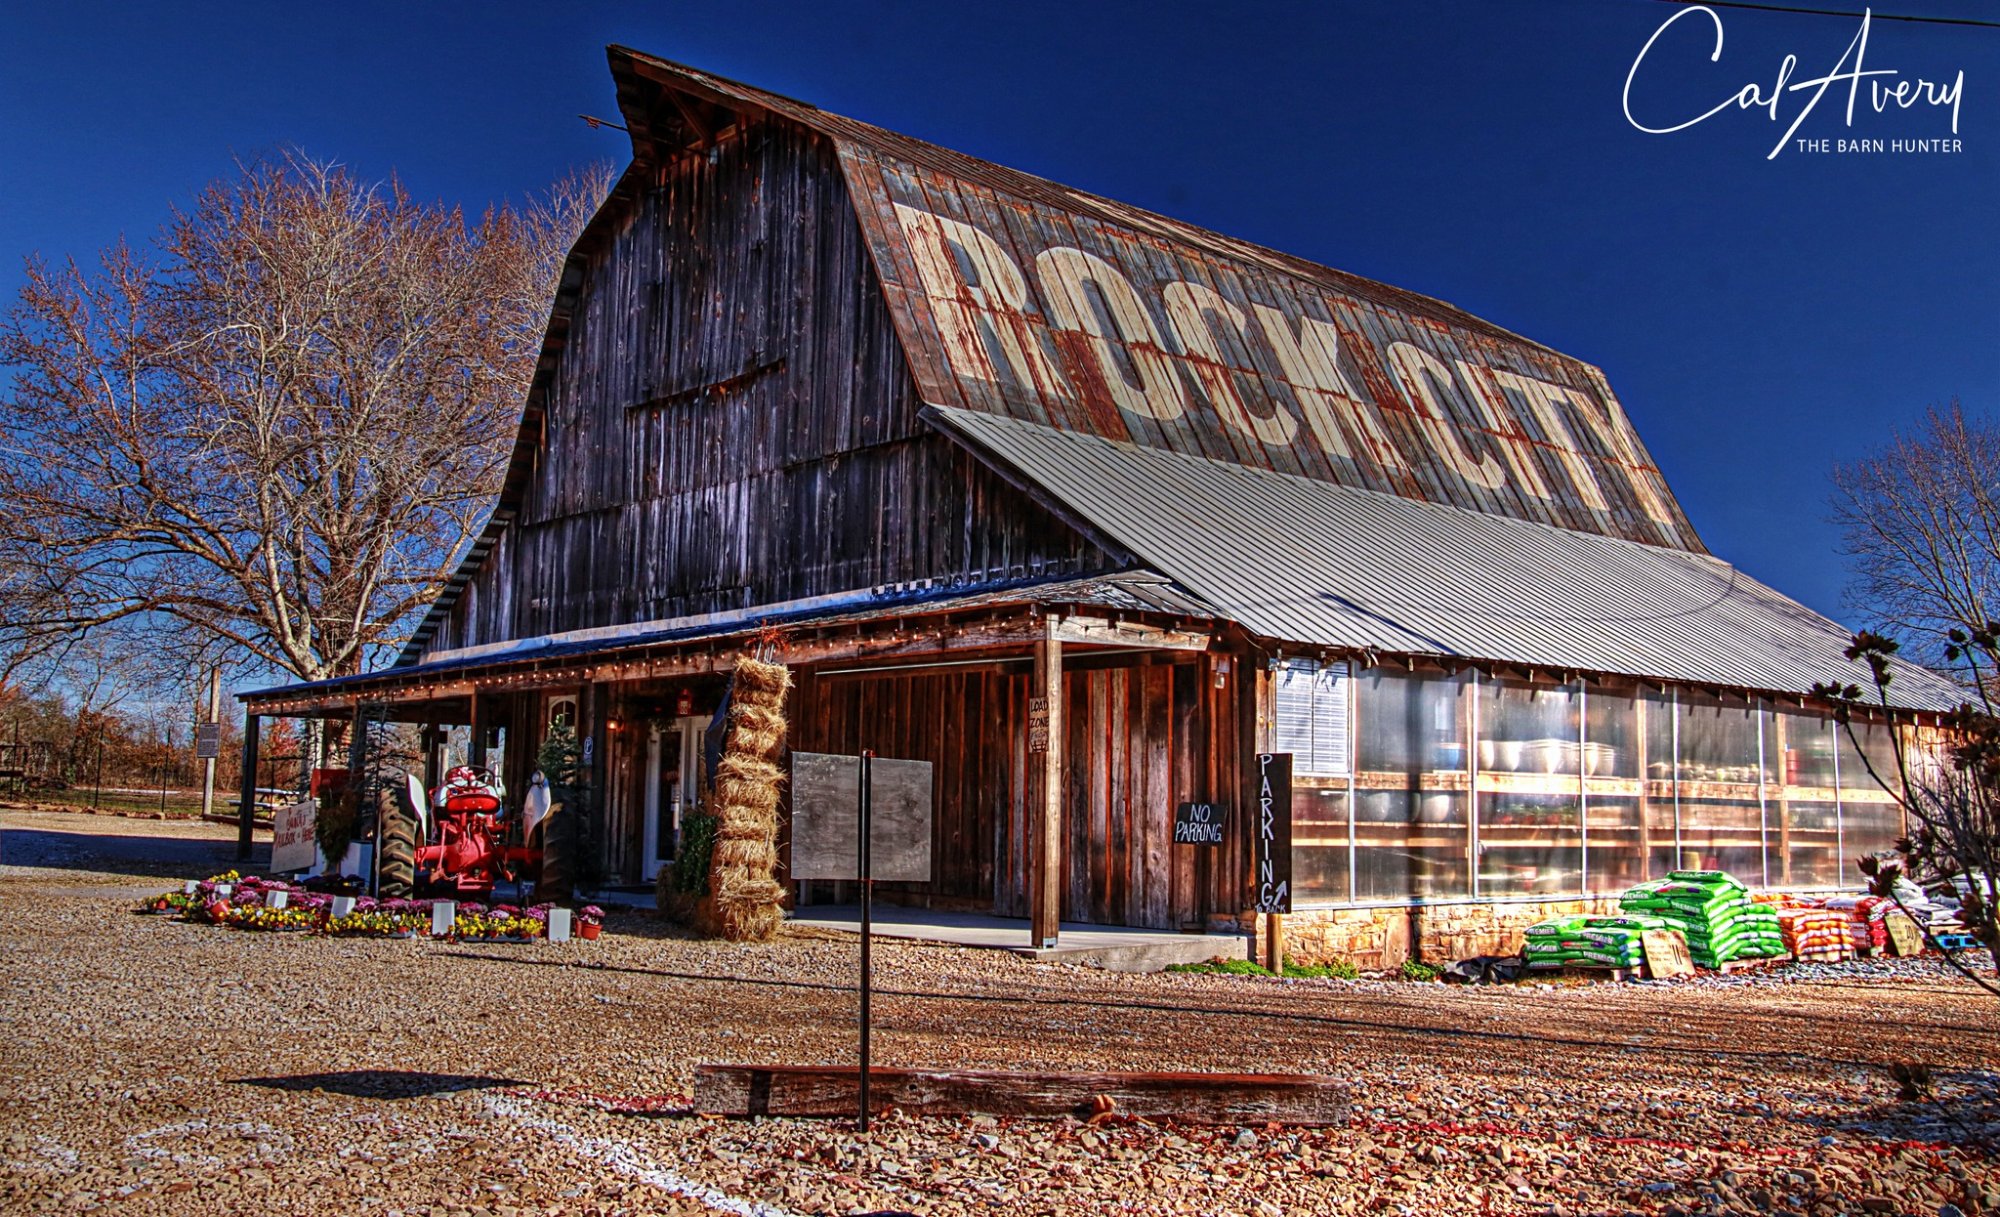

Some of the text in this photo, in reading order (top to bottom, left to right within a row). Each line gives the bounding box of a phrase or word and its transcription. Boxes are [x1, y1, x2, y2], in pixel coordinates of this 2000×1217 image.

[892, 201, 1674, 526] ROCK CITY
[1030, 700, 1049, 712] LOAD
[1030, 716, 1049, 728] ZONE
[1190, 804, 1211, 822] NO
[1174, 820, 1223, 843] PARKING
[1260, 754, 1275, 907] PARKING
